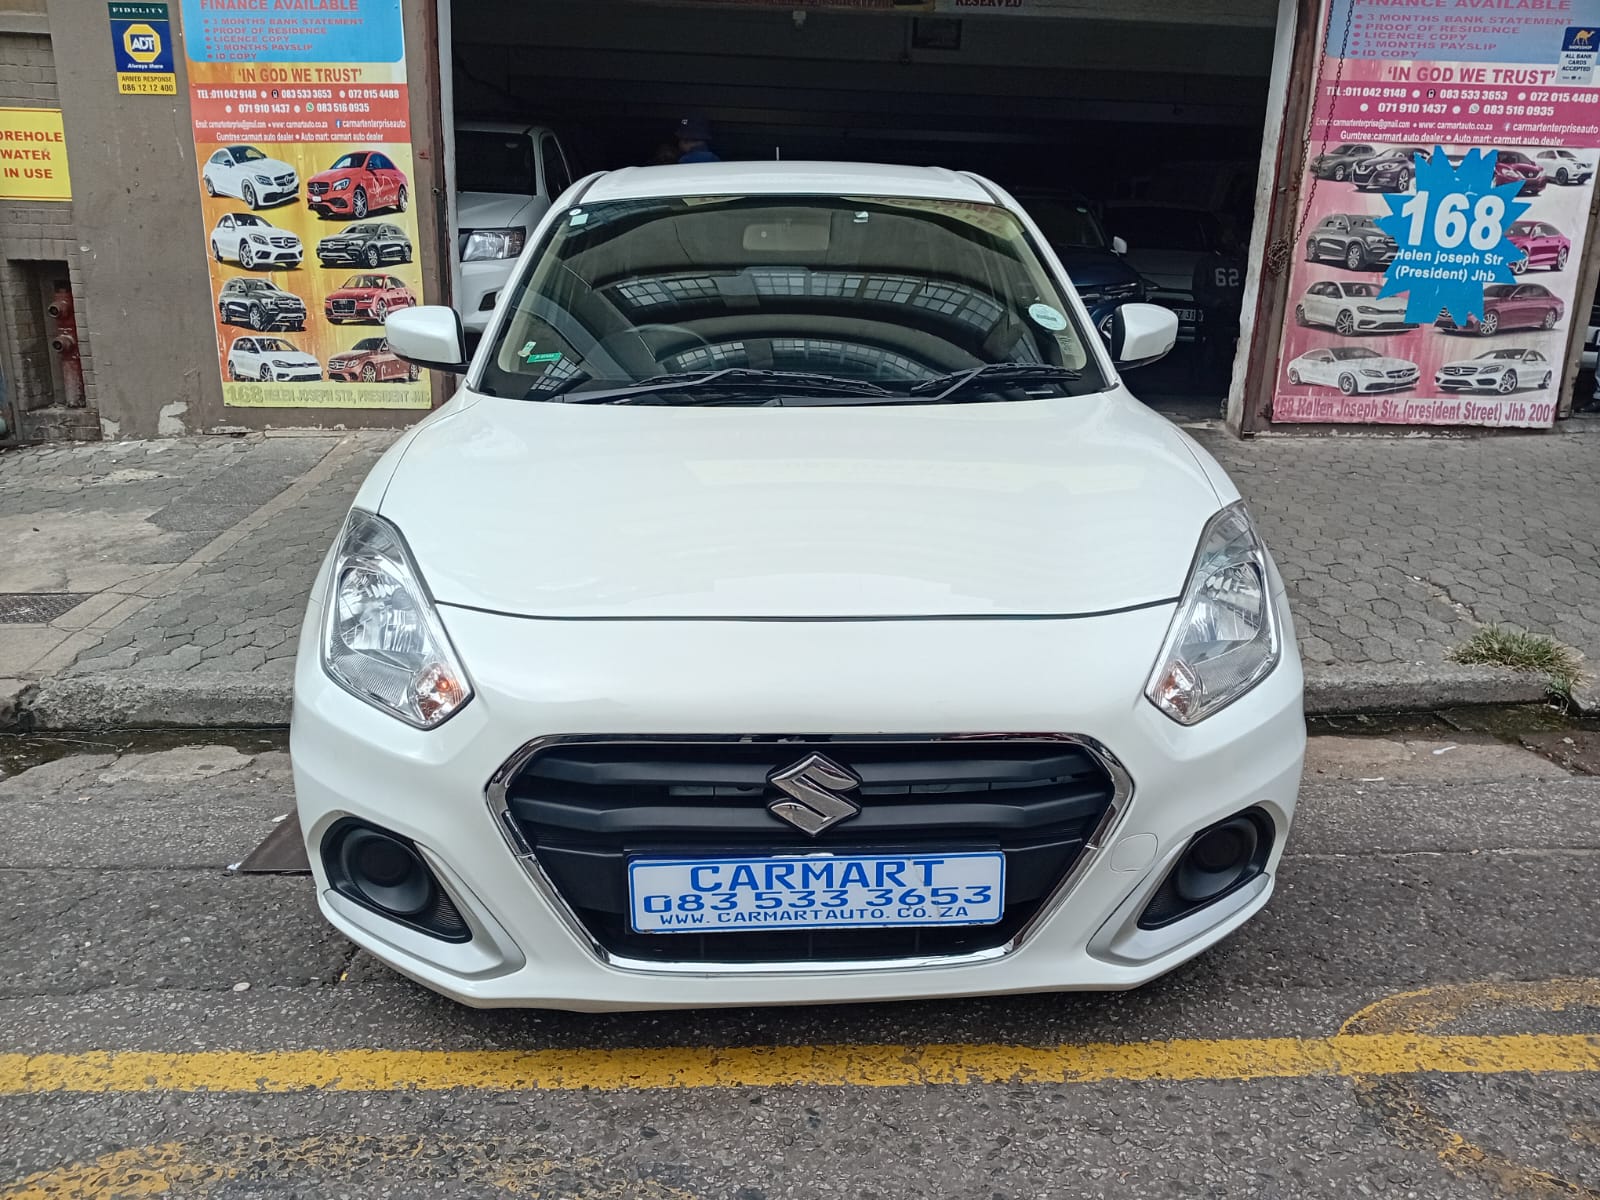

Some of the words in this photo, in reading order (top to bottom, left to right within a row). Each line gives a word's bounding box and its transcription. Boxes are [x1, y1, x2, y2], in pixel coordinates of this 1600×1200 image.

[200, 0, 268, 10] FINANCE
[274, 0, 359, 10] AVAILABLE
[1455, 0, 1571, 10] AVAILABLE
[1489, 17, 1574, 25] STATEMENT
[1440, 25, 1521, 33] RESIDENCE
[132, 36, 154, 50] ADT
[260, 68, 288, 82] GOD
[292, 68, 312, 82] WE
[1417, 67, 1454, 82] GOD
[1459, 68, 1486, 82] WE
[348, 90, 362, 98] 072
[1363, 88, 1381, 97] 042
[1383, 88, 1407, 98] 9148
[1440, 90, 1460, 99] 083
[1461, 90, 1480, 100] 533
[1482, 91, 1508, 100] 3653
[1530, 92, 1549, 102] 072
[1551, 92, 1570, 102] 015
[1571, 93, 1598, 103] 4488
[239, 104, 253, 113] 071
[254, 104, 269, 113] 910
[271, 104, 290, 113] 1437
[317, 103, 332, 112] 083
[334, 103, 347, 112] 516
[349, 103, 369, 112] 0935
[1378, 103, 1397, 112] 071
[1399, 103, 1419, 113] 910
[1422, 104, 1447, 114] 1437
[1483, 105, 1503, 114] 083
[1506, 106, 1524, 115] 516
[1526, 106, 1554, 116] 0935
[343, 119, 406, 129] carmartenterpriseauto
[1437, 122, 1493, 130] carmartauto.co.za
[1513, 123, 1598, 134] carmartenterpriseauto
[264, 132, 276, 141] auto
[277, 132, 293, 141] dealer
[301, 132, 314, 141] Auto
[331, 132, 352, 141] carmart
[353, 132, 365, 141] auto
[366, 132, 383, 141] dealer
[1404, 133, 1420, 141] auto
[1421, 133, 1443, 142] dealer
[1454, 134, 1473, 142] Auto
[1494, 136, 1522, 144] carmart
[1541, 137, 1564, 145] dealer
[0, 149, 51, 160] WATER
[4, 167, 19, 178] IN
[24, 168, 53, 179] USE
[1401, 191, 1505, 250] 168
[1395, 249, 1432, 262] Helen
[1434, 250, 1480, 265] joseph
[1484, 254, 1504, 265] Str
[1215, 268, 1239, 286] 62
[1396, 266, 1468, 283] (President)
[1471, 270, 1496, 282] Jhb
[226, 385, 263, 403] 168
[297, 389, 333, 402] JOSEPH
[358, 390, 409, 402] PRESIDENT
[1336, 398, 1378, 421] Joseph
[1381, 400, 1400, 418] Str.
[1404, 400, 1462, 421] (president
[1464, 402, 1502, 426] Street)
[1505, 402, 1525, 421] Jhb
[690, 860, 944, 892] CARMART
[644, 894, 738, 913] 083
[754, 890, 848, 910] 533
[866, 886, 992, 907] 3653
